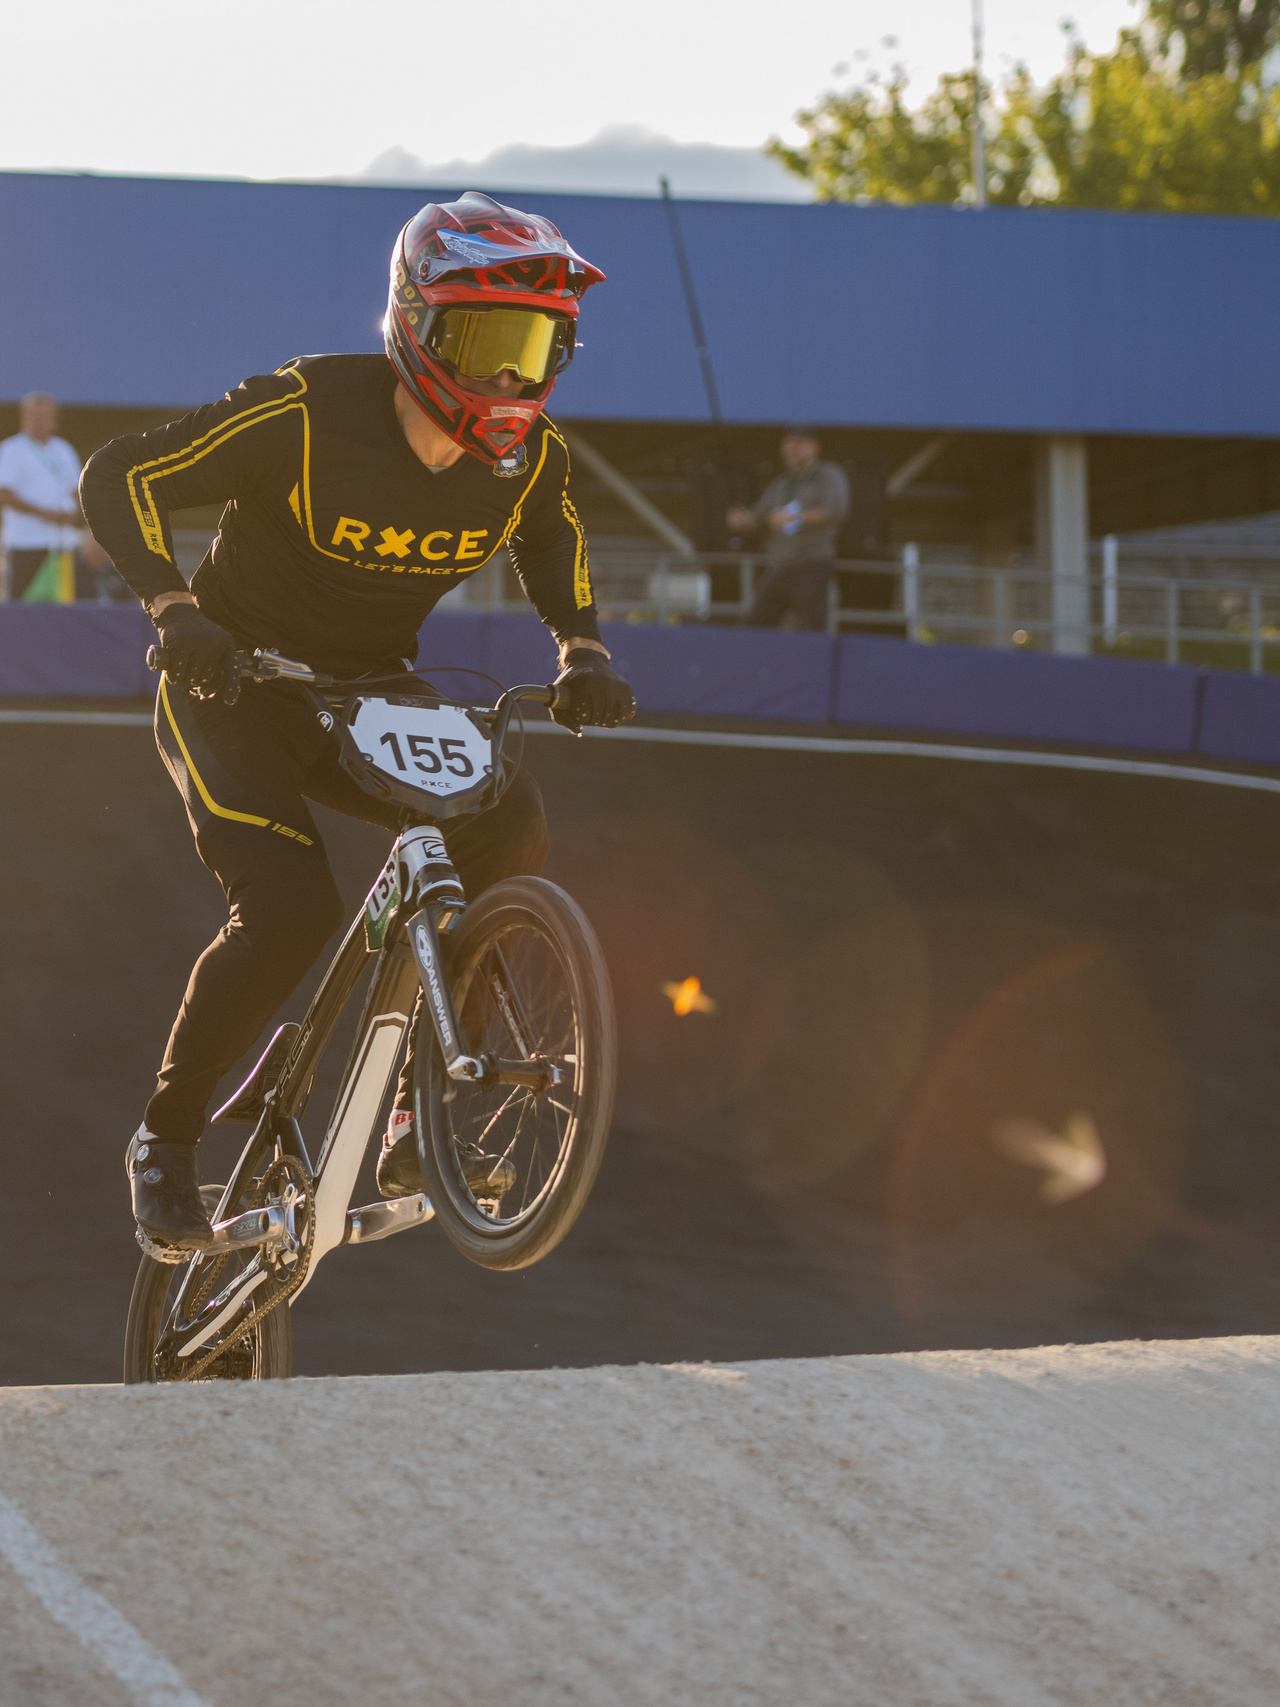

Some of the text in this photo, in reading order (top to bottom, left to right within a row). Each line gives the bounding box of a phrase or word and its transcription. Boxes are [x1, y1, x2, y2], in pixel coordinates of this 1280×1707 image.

[353, 560, 455, 575] LET'S RACE
[380, 731, 474, 778] 155
[271, 822, 314, 846] 155
[427, 967, 452, 1047] ANSWER
